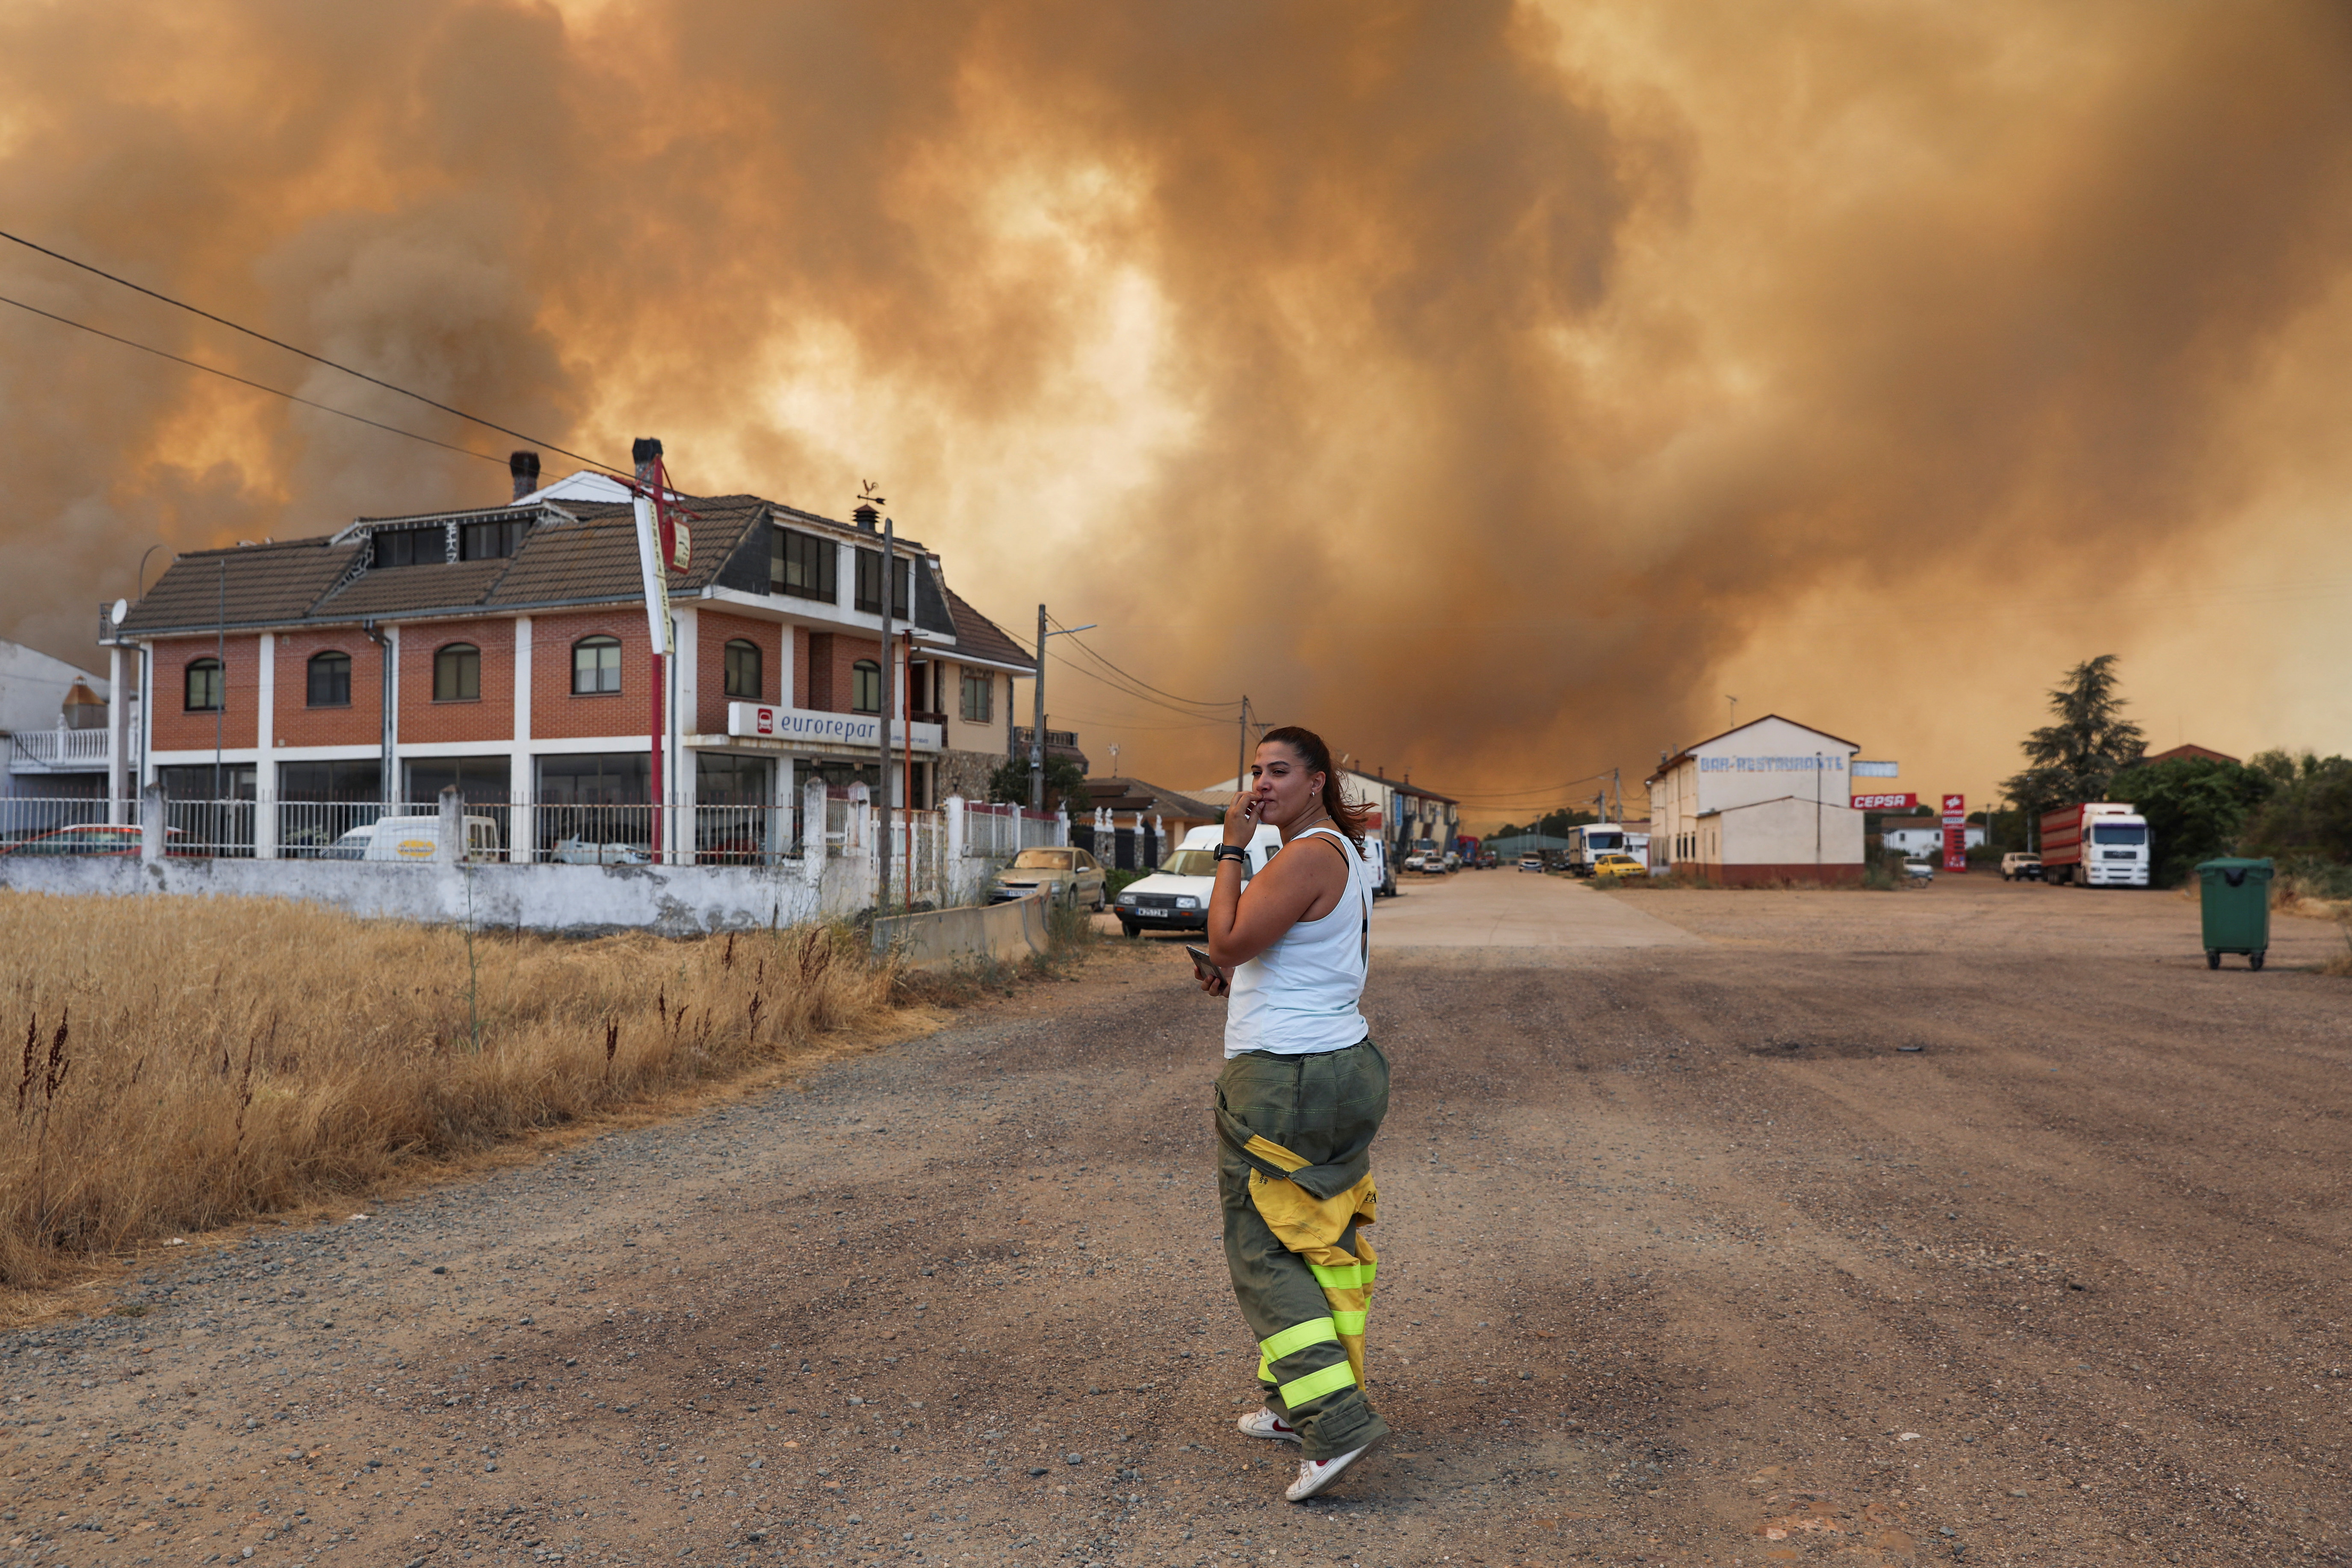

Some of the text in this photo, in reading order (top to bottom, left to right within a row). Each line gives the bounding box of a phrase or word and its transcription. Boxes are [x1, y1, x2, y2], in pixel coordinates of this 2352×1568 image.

[661, 582, 673, 646] VENTA
[782, 715, 875, 742] eurorepar
[1854, 794, 1906, 808] CEPSA
